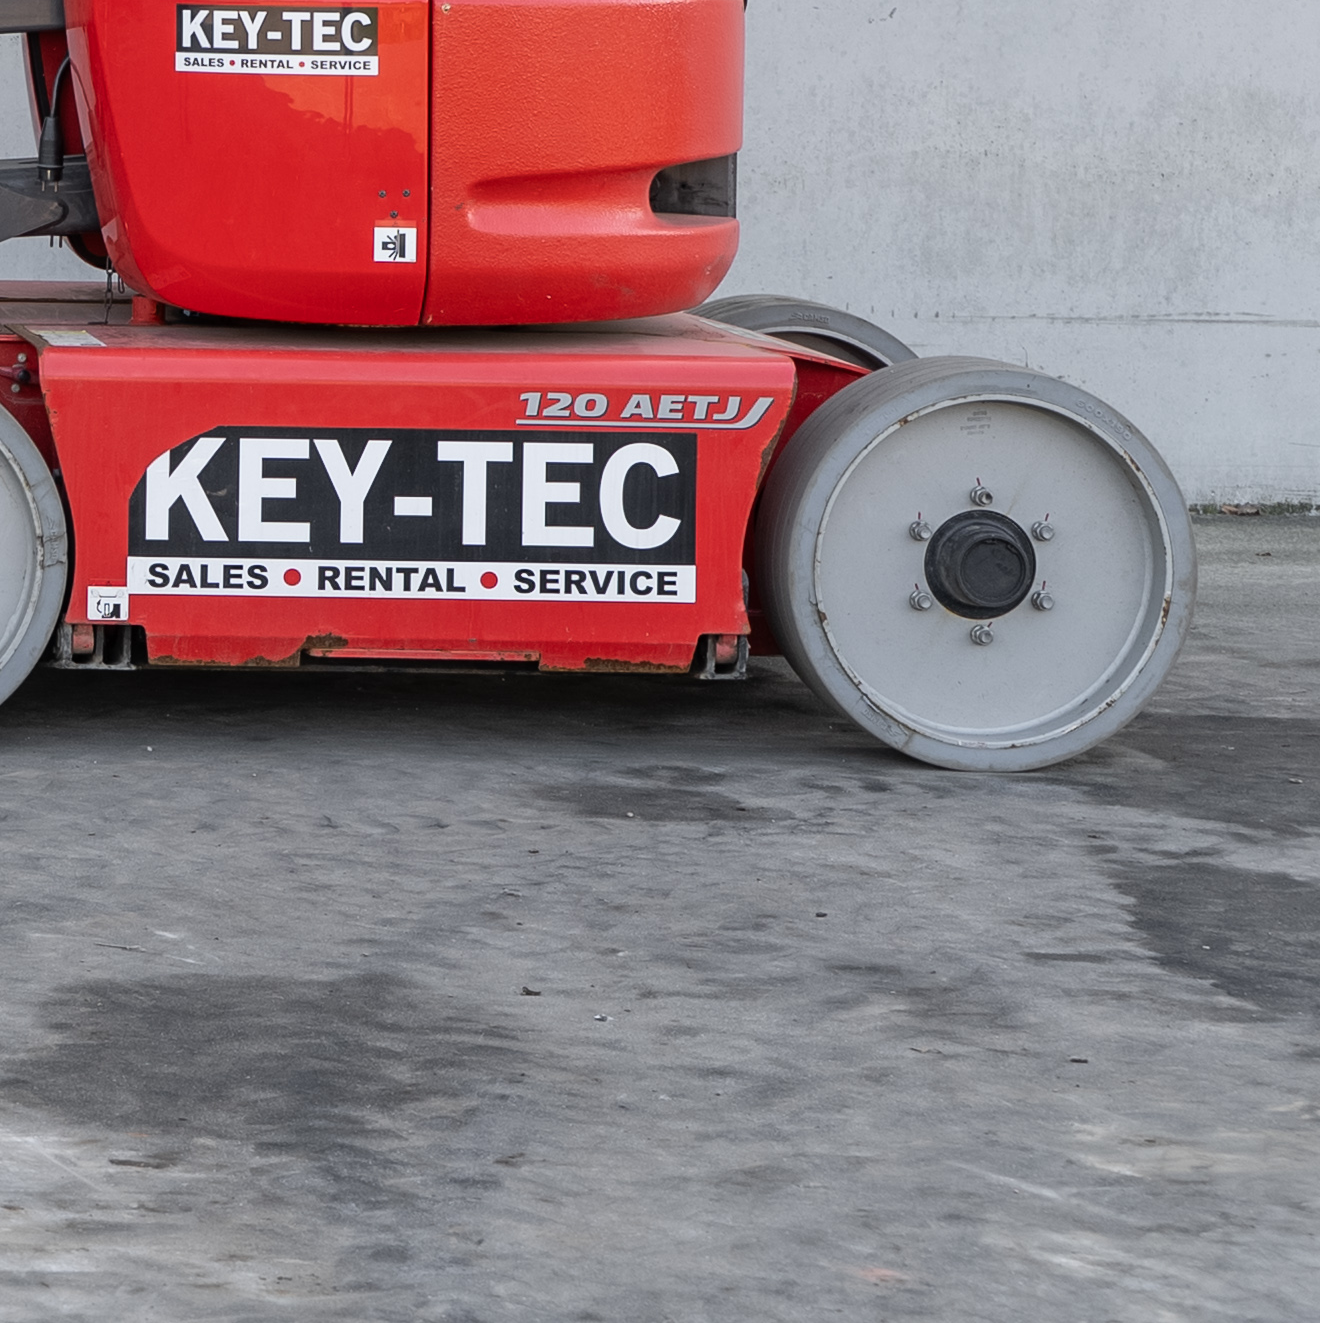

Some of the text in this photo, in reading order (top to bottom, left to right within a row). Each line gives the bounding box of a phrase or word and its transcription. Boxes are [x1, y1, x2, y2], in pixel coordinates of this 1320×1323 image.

[182, 9, 373, 52] KEY-TEC
[183, 57, 371, 71] SALES RENTAL SERVICE
[519, 392, 741, 420] 120 AETJ
[145, 437, 681, 549] KEY-TEC
[147, 563, 678, 597] SALES RENTAL SERVICE
